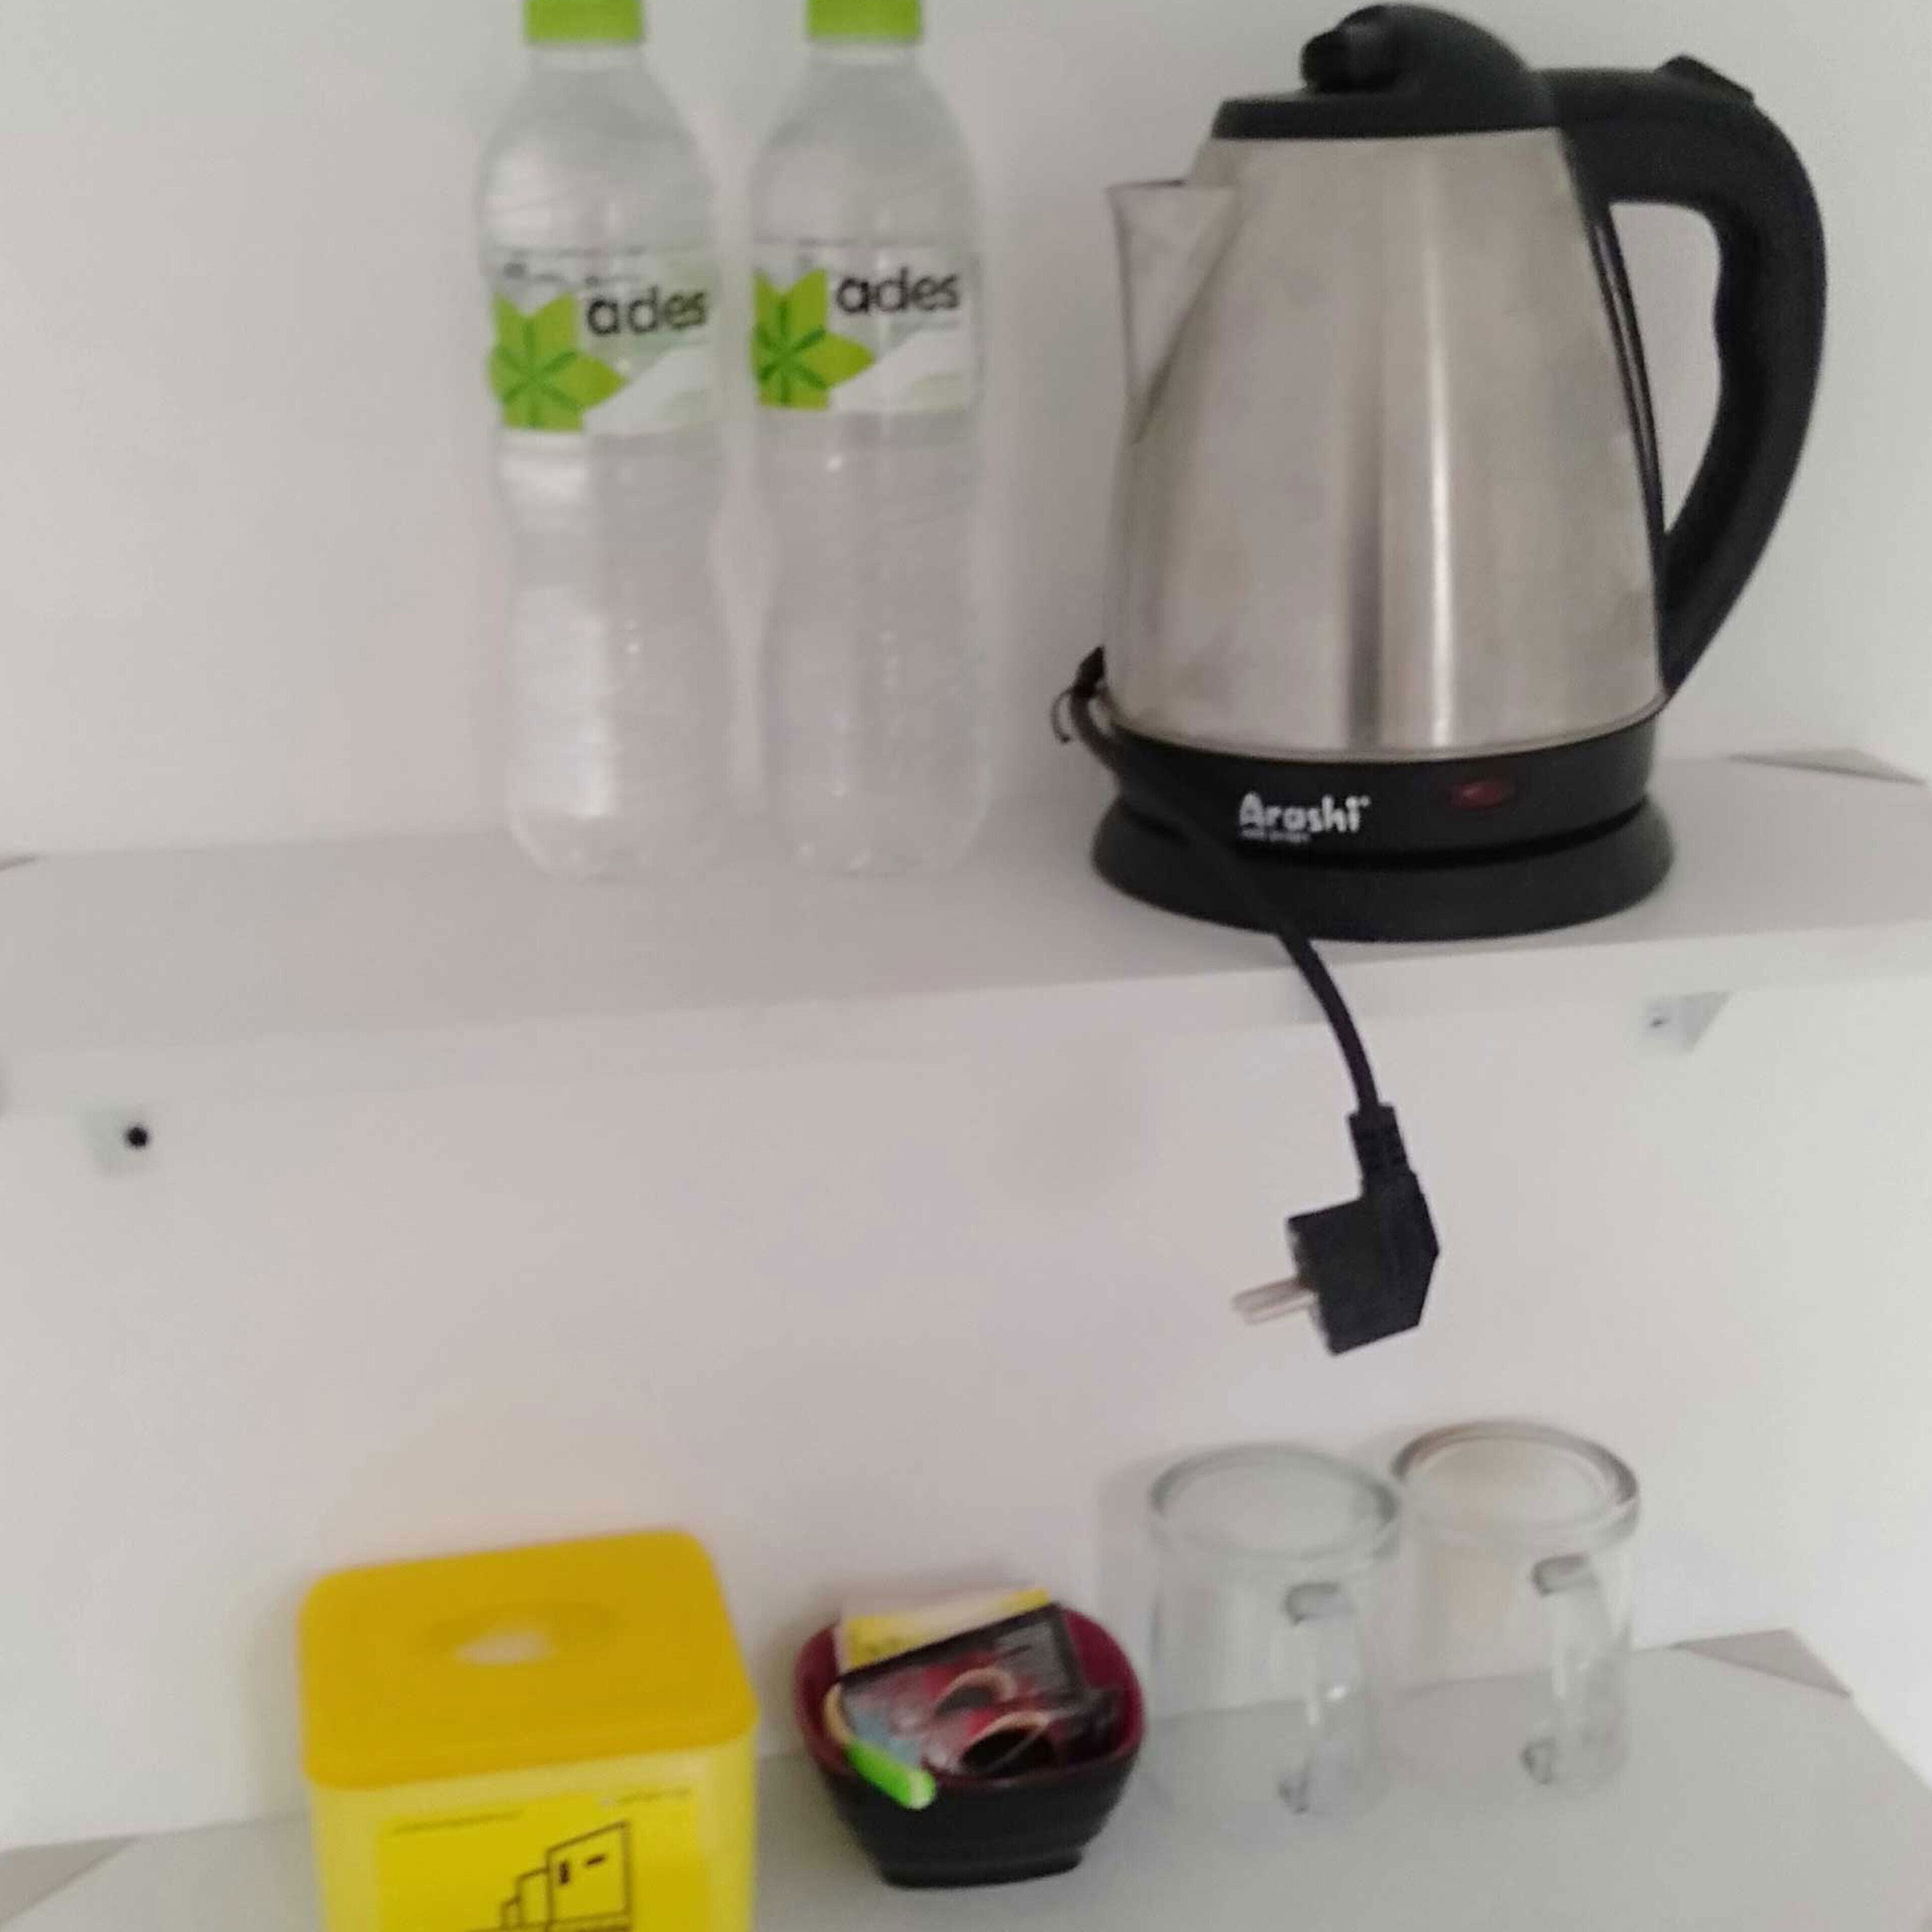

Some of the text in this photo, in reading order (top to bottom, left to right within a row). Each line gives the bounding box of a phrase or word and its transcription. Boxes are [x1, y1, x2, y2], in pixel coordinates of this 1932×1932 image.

[587, 286, 707, 334] ades
[835, 266, 959, 314] ades
[1239, 791, 1360, 832] Arashi
